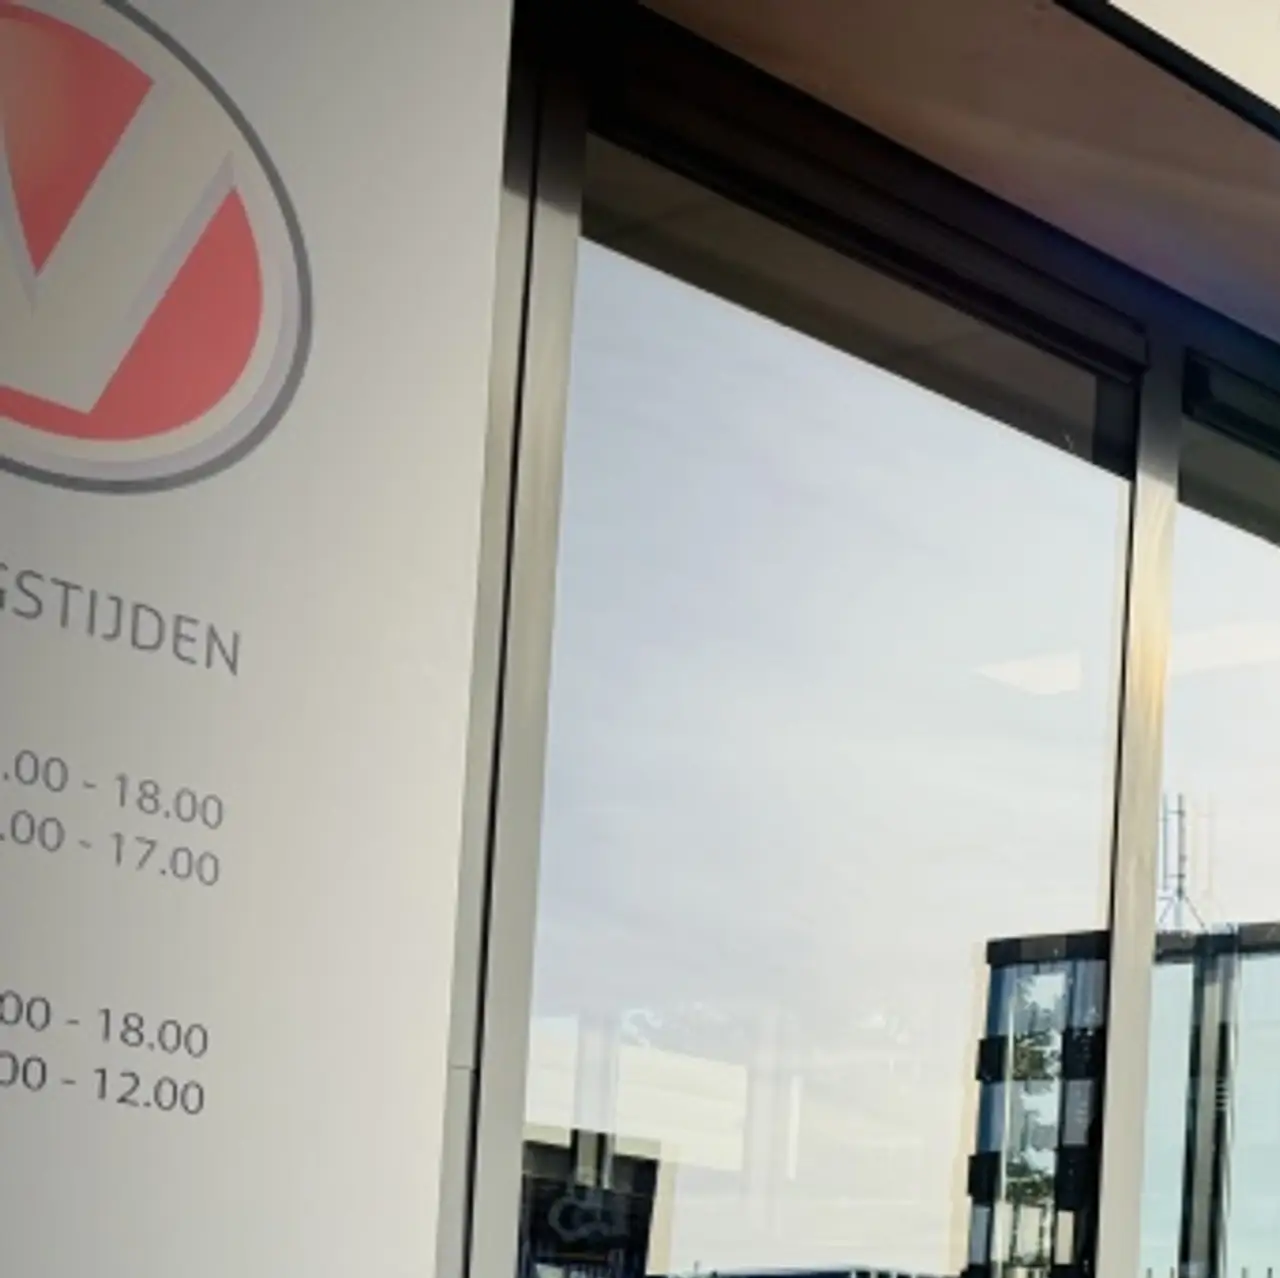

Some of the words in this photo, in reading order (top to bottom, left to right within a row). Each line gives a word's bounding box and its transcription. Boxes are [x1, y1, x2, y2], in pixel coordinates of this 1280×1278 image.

[115, 772, 223, 830] 18.00
[110, 832, 220, 887] 17.00
[99, 1008, 208, 1058] 18.00
[94, 1067, 204, 1115] 12.00
